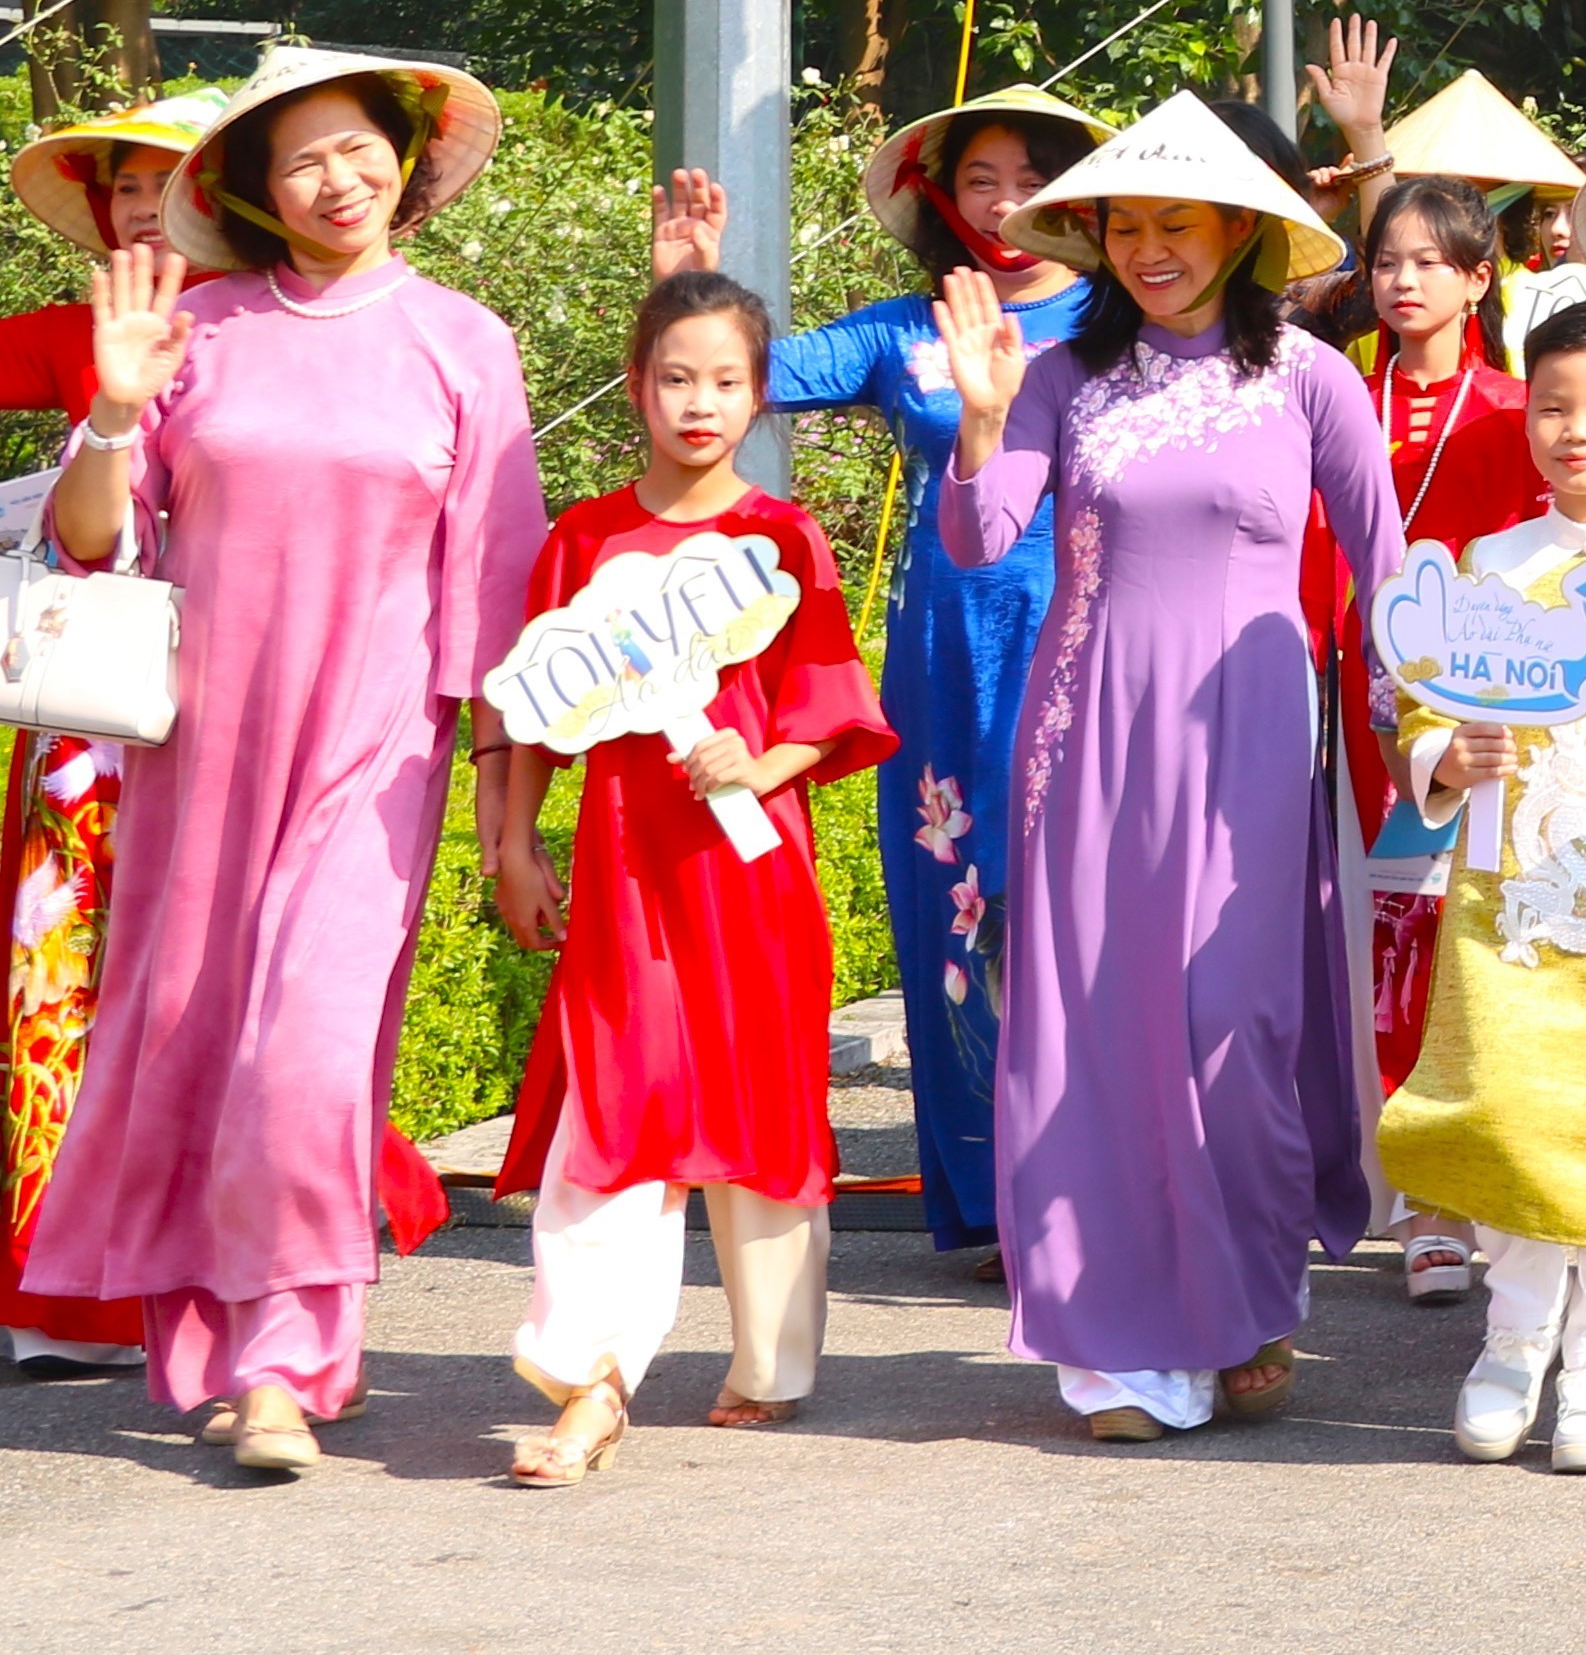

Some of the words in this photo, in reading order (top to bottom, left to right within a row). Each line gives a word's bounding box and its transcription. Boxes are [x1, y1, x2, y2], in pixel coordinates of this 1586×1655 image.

[498, 627, 617, 729] TÔI
[630, 546, 774, 657] YÊU
[1450, 651, 1502, 683] HÀ
